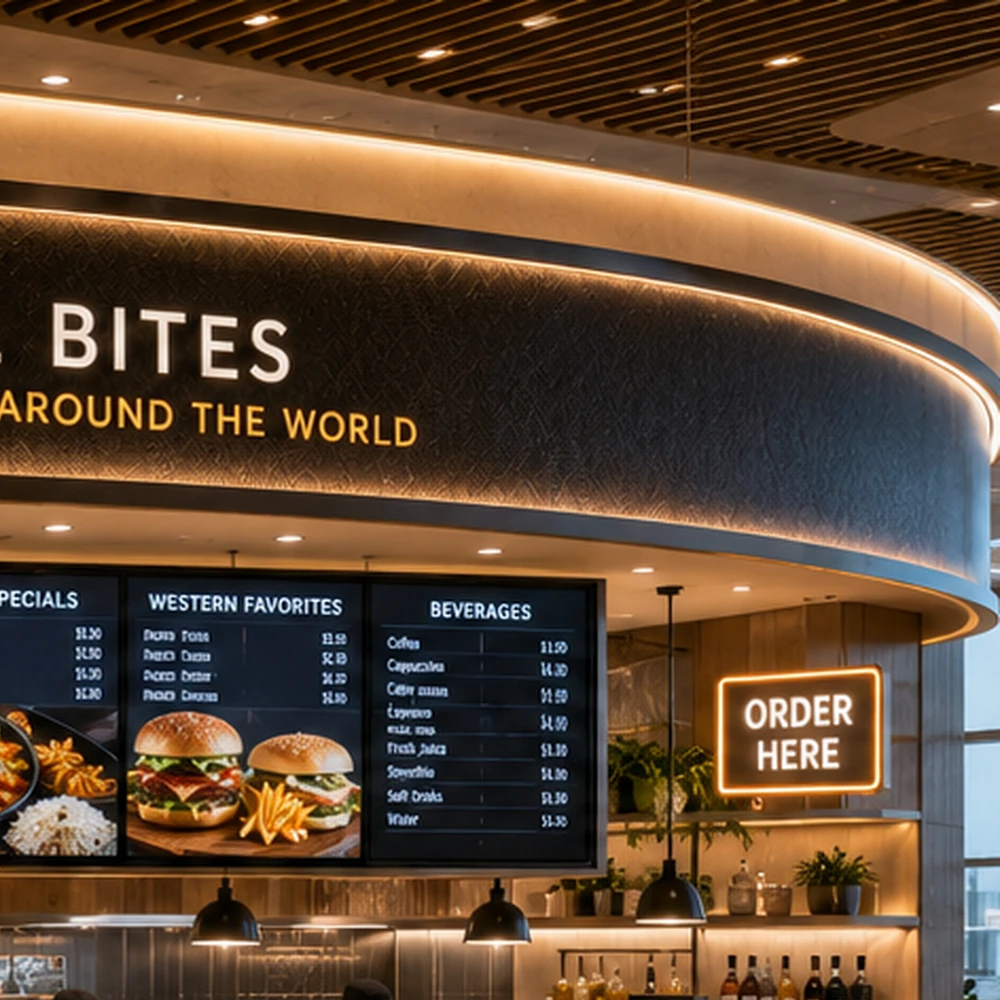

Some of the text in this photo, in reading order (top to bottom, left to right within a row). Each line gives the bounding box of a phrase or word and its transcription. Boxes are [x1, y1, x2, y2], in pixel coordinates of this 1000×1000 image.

[52, 302, 292, 383] BITES
[191, 401, 266, 438] THE
[282, 407, 418, 448] WORLD
[148, 593, 343, 616] WESTERN FAVORITES
[430, 600, 532, 621] BEVERAGES
[744, 694, 853, 730] ORDER
[757, 737, 840, 771] HERE
